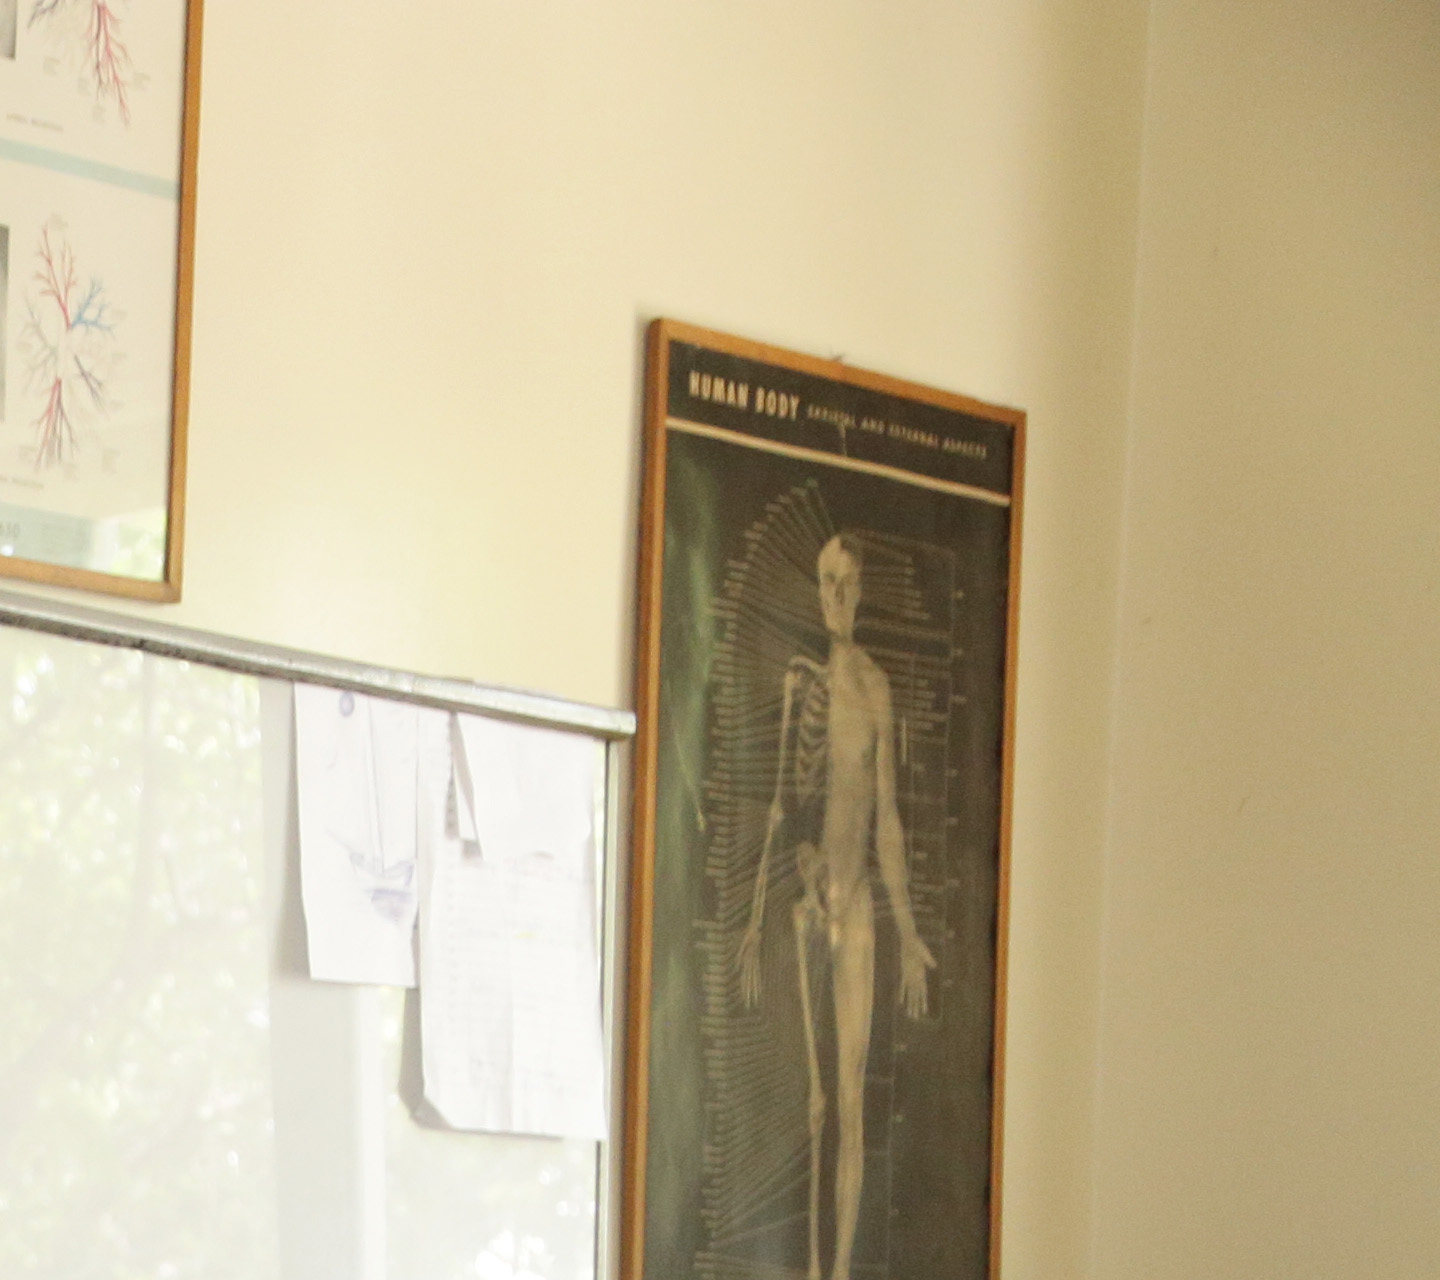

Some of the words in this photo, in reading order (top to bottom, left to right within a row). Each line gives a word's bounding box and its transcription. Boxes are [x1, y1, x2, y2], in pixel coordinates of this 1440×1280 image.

[688, 369, 749, 411] HUMAN
[755, 385, 800, 422] BODY
[861, 415, 885, 435] AND
